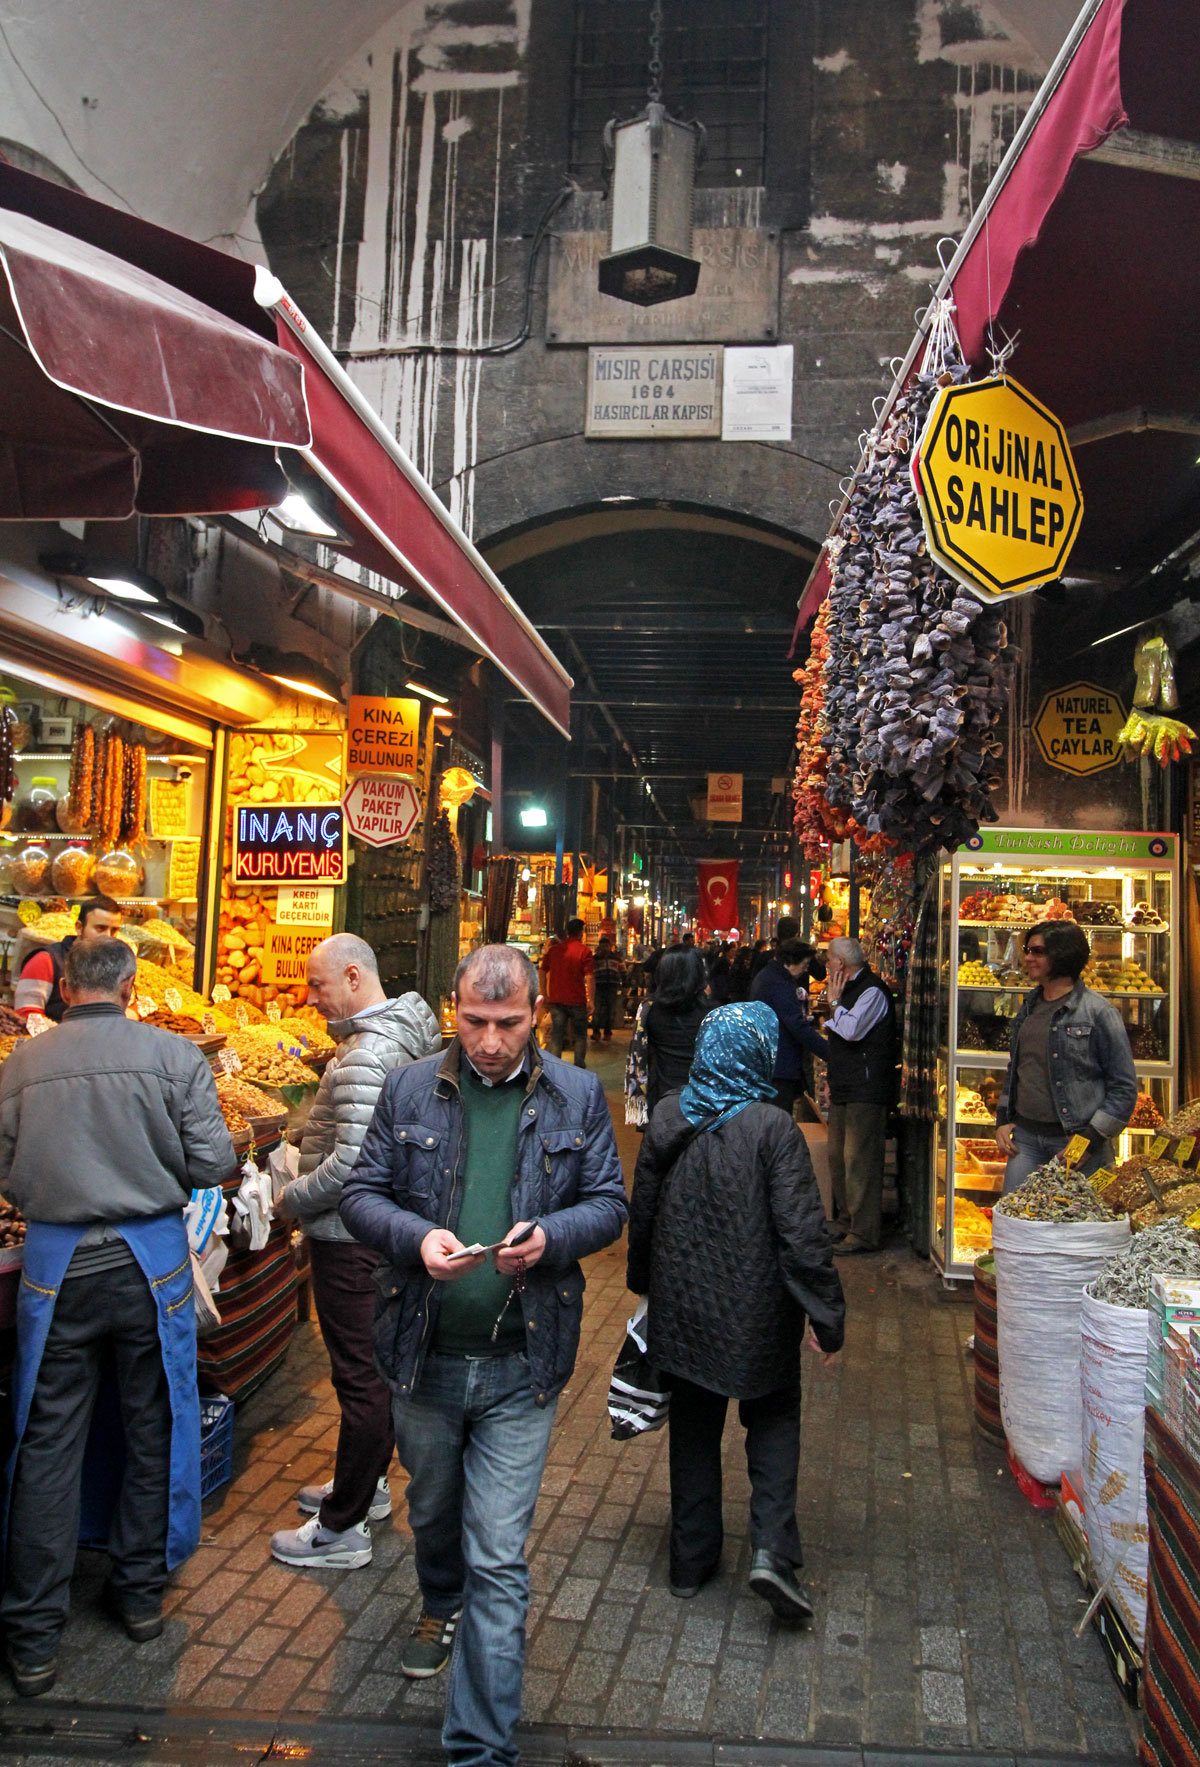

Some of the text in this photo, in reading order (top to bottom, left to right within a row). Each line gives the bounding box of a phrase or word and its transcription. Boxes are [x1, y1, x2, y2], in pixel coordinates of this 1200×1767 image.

[595, 358, 715, 381] MISIR ÇARŞISI
[593, 404, 713, 420] HASIRCILAR KAPISI
[946, 474, 1065, 549] SAHLEP
[1055, 696, 1113, 715] NATUREL
[363, 707, 405, 726] KINA
[1062, 717, 1102, 735] TEA
[351, 728, 414, 748] ÇEREZİ
[349, 748, 414, 768] BULUNUR
[1050, 738, 1114, 760] ÇAYLAR
[362, 780, 405, 800] VAKUM
[361, 797, 401, 817] PAKET
[239, 809, 341, 848] İNANÇ
[356, 814, 403, 834] YAPILIR
[993, 833, 1138, 857] Turkish Delight
[236, 848, 342, 879] KURUYEMİŞ
[292, 890, 319, 900] KREDİ
[292, 901, 318, 911] KARTI
[271, 932, 326, 959] KINA ÇERE
[275, 959, 307, 979] BULUN
